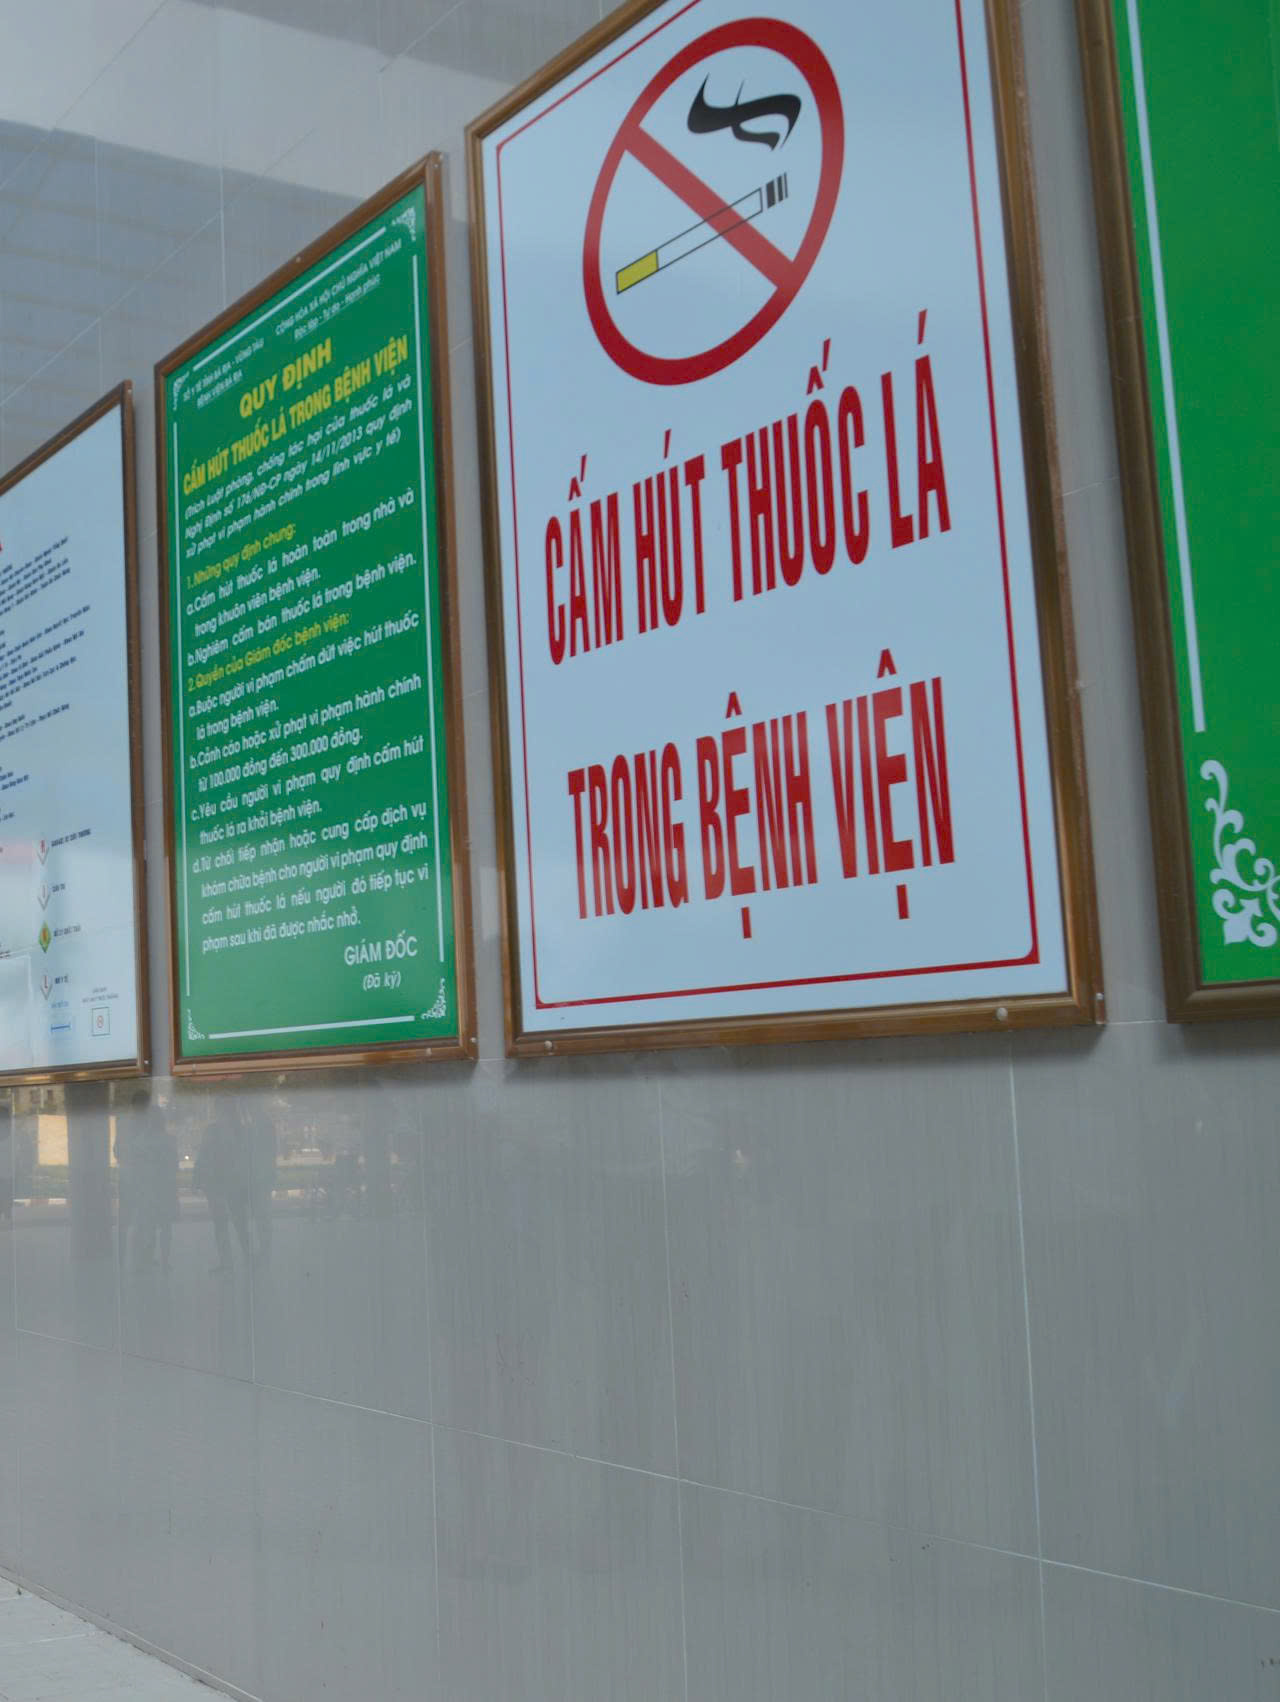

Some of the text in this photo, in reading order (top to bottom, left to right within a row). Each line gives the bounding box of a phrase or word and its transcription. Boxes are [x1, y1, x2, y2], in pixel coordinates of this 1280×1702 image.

[183, 459, 205, 495] CẤM
[207, 448, 229, 480] HÚT
[231, 418, 269, 464] THUỐC
[271, 407, 287, 440] LÁ
[289, 384, 331, 428] TRONG
[334, 358, 371, 402] BỆNH
[373, 335, 408, 376] VIỆN
[239, 374, 277, 417] QUY
[282, 338, 331, 390] ĐỊNH
[545, 309, 951, 665] CẤM HÚT THUỐC LÁ
[568, 648, 955, 939] TRONG BỆNH VIỆN
[344, 930, 417, 966] GIÁM ĐỐC
[362, 970, 401, 991] (Đã ký)
